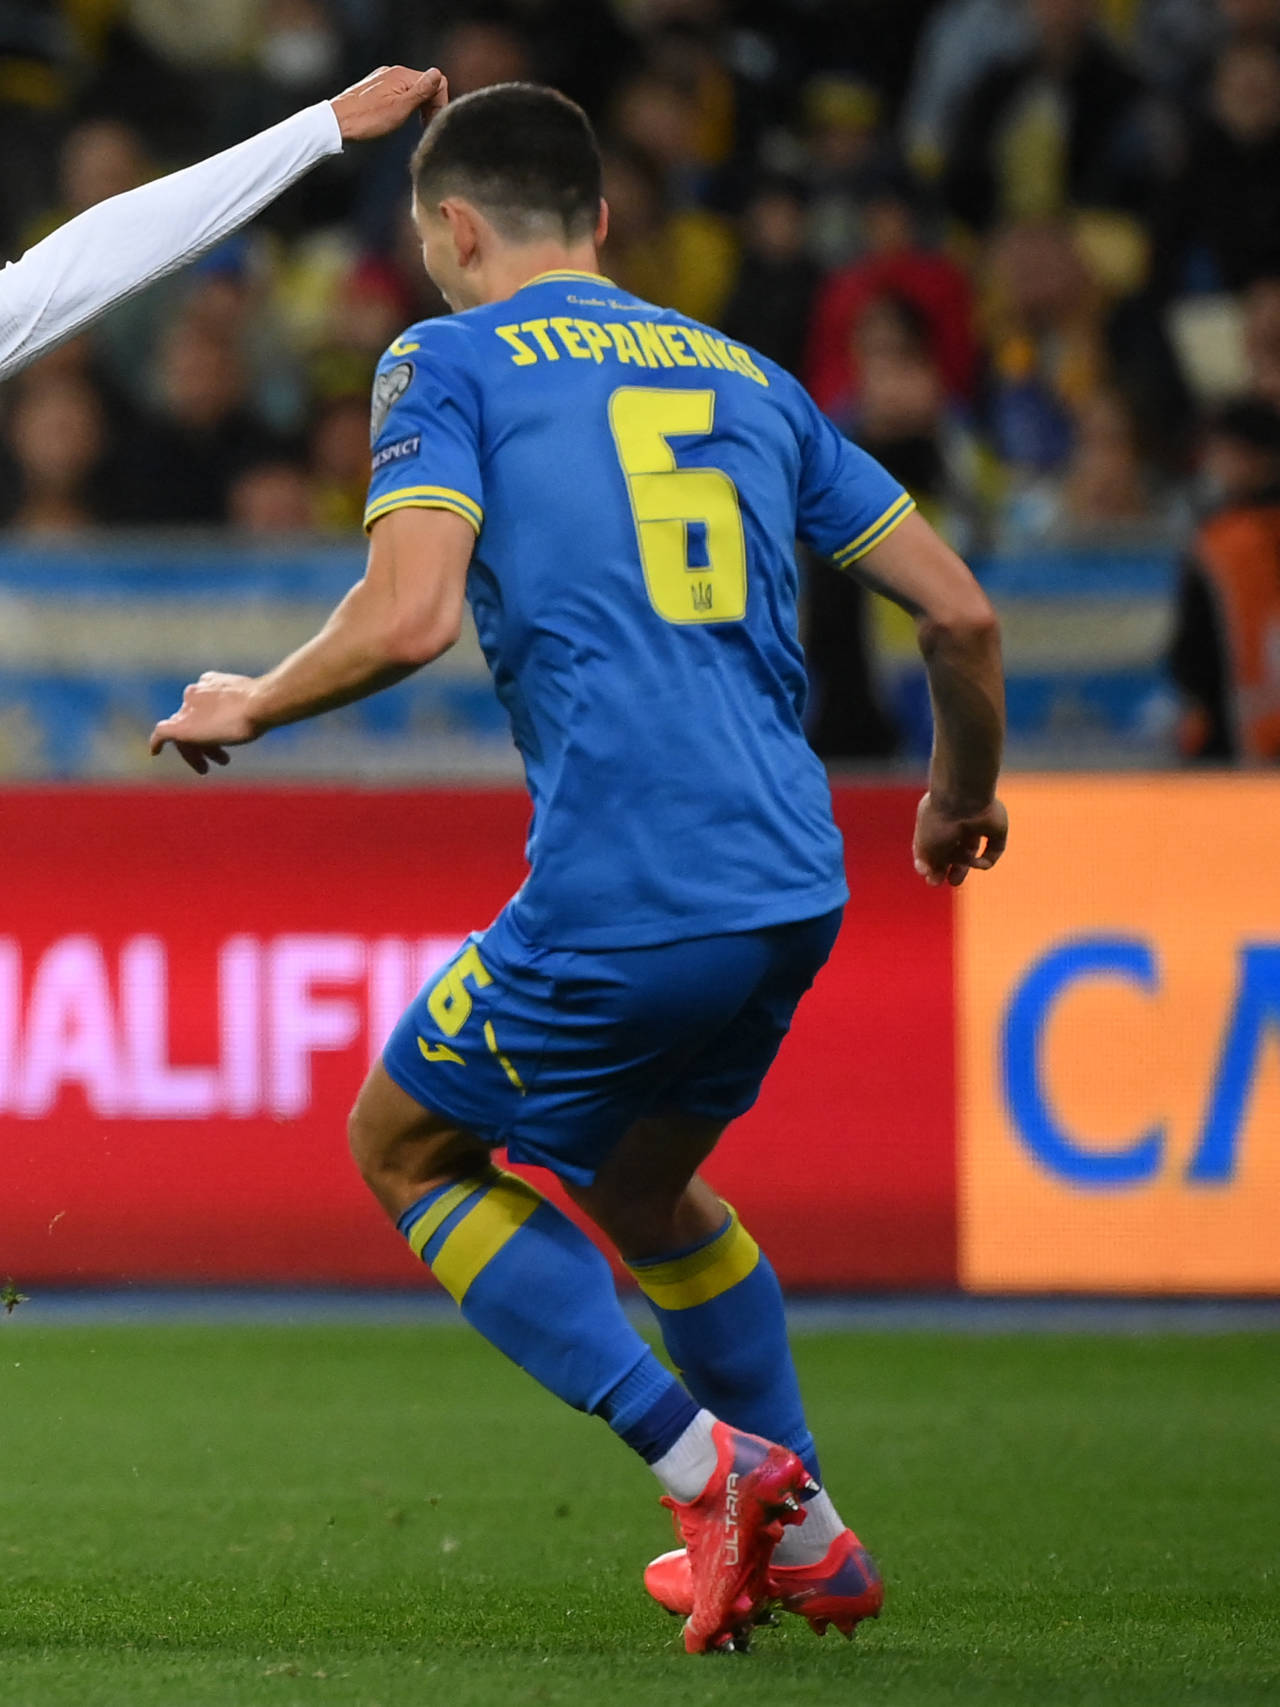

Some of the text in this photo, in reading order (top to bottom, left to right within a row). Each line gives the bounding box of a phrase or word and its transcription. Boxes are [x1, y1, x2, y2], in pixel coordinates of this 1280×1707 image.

[495, 317, 769, 387] STEPANENKO
[608, 385, 748, 625] 6
[427, 944, 493, 1038] 6
[724, 1472, 740, 1566] ULTRA
